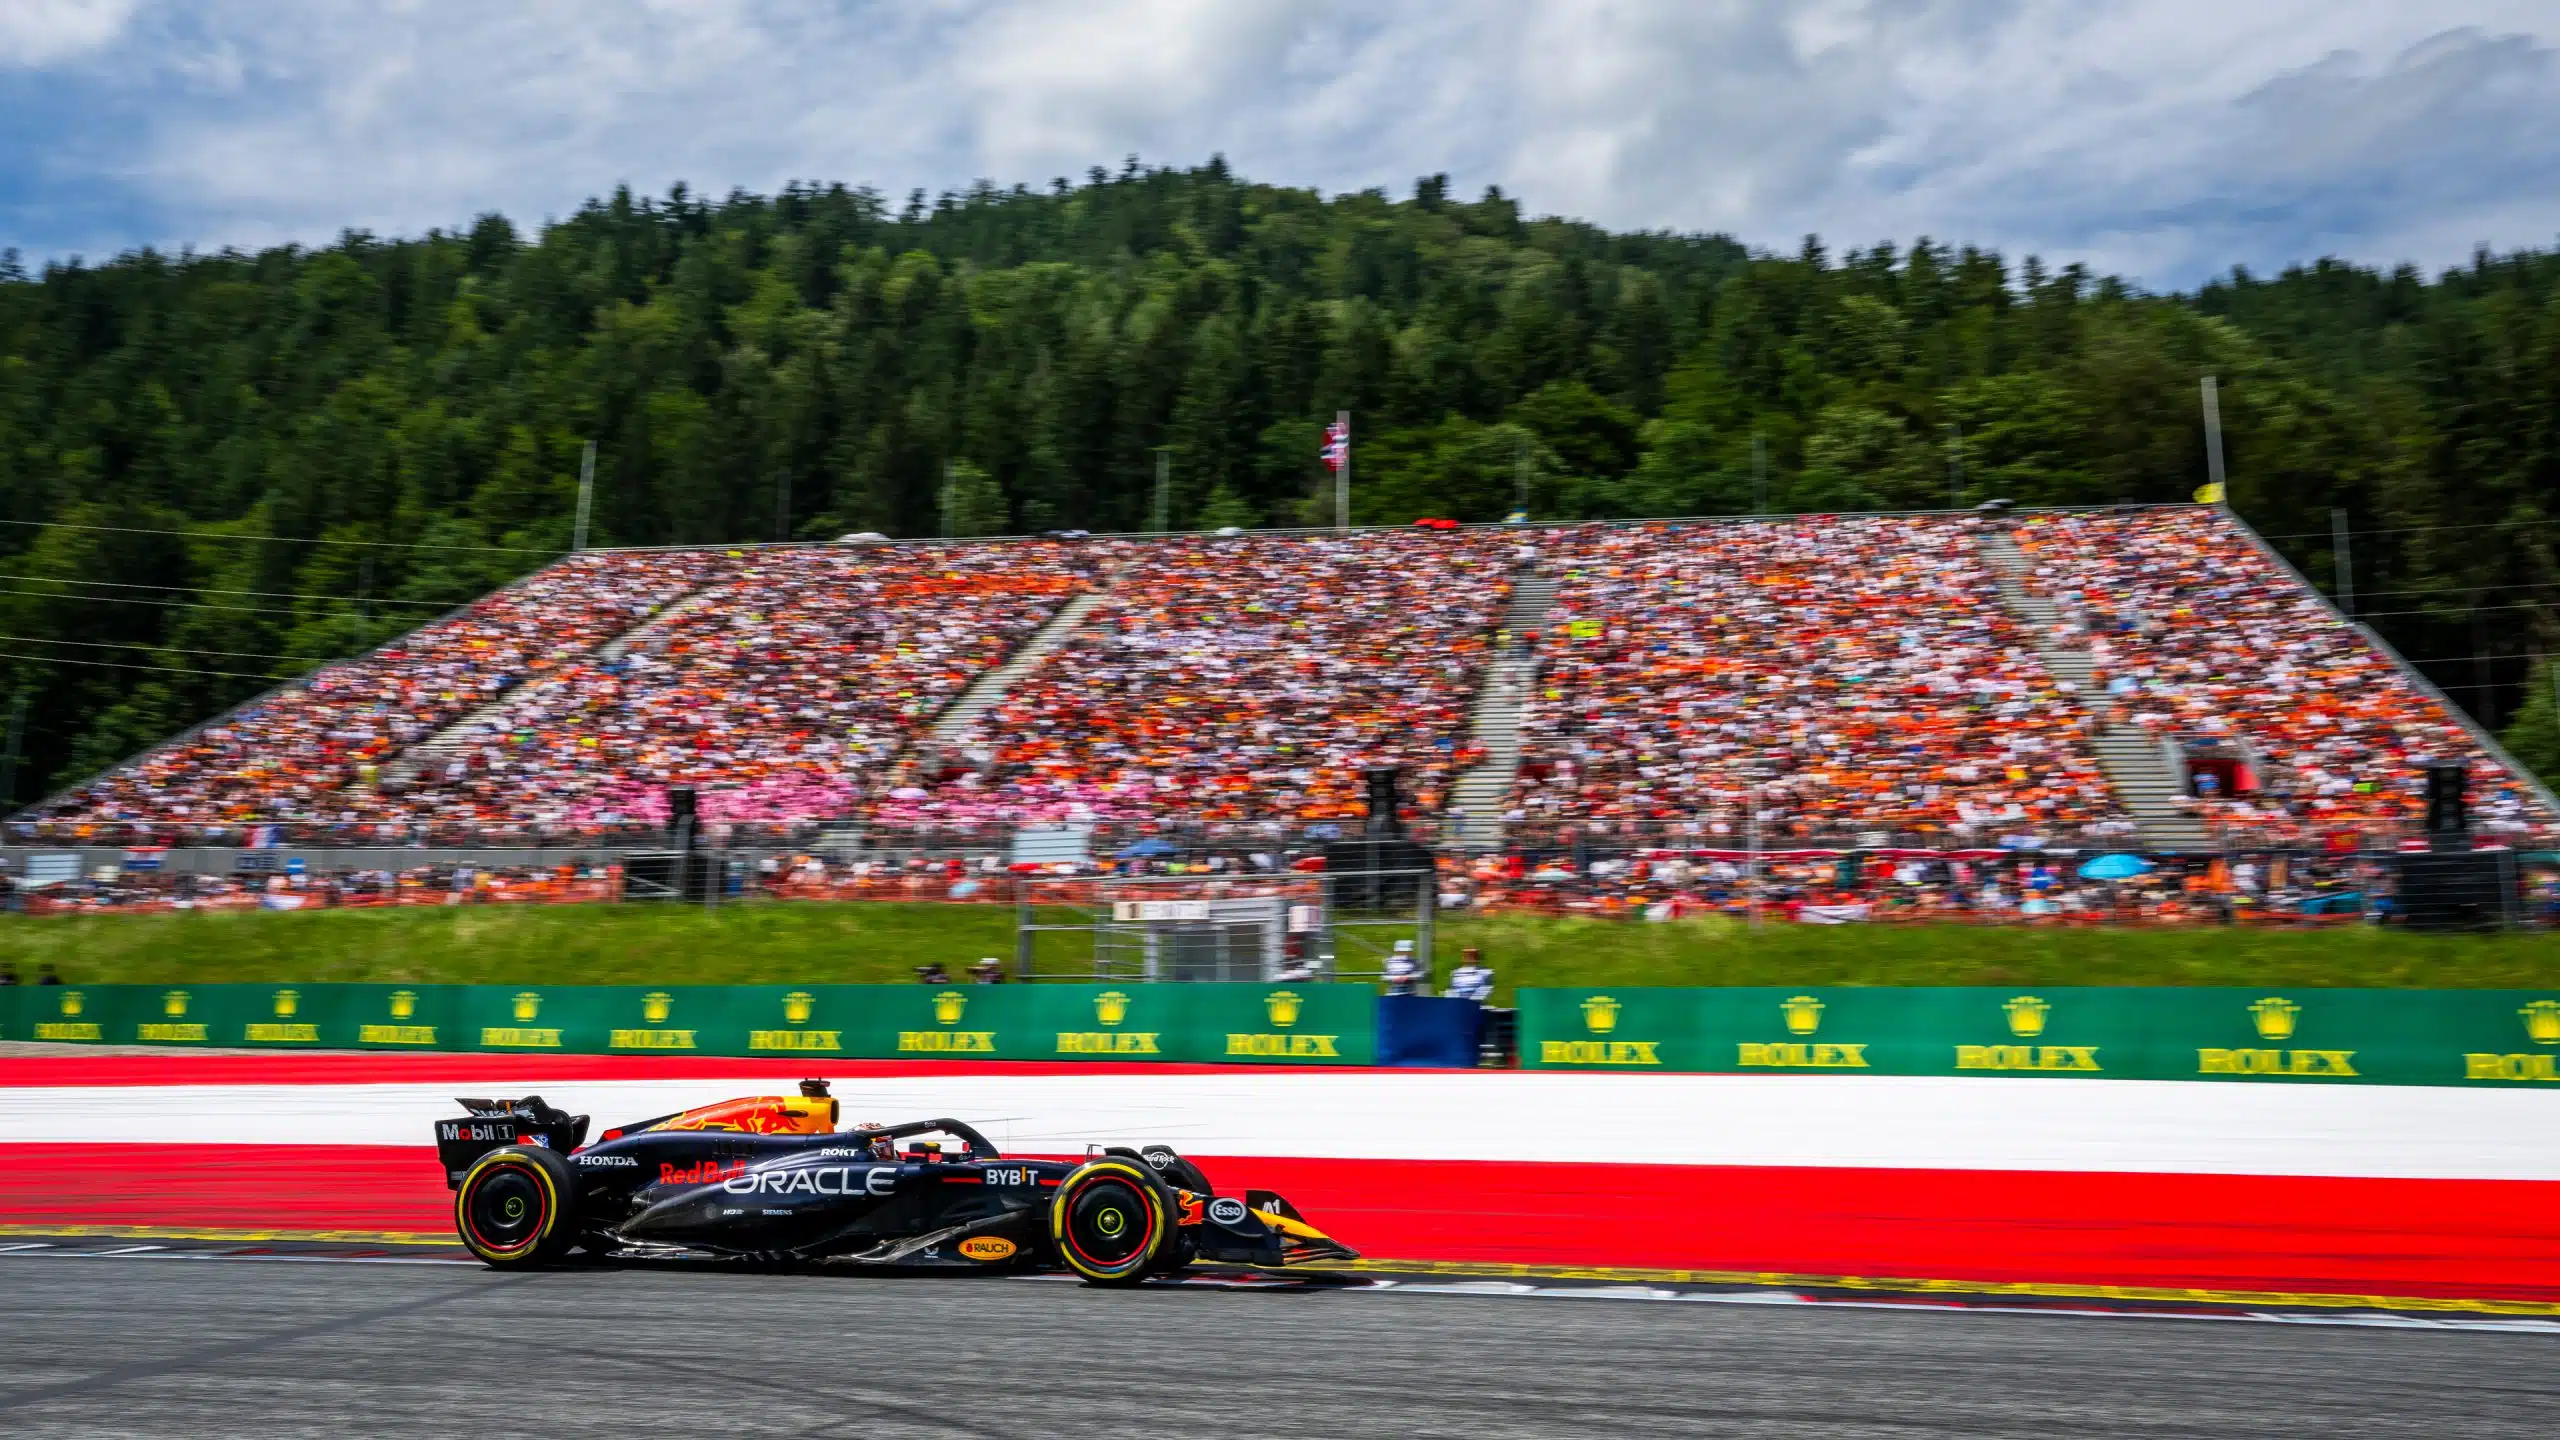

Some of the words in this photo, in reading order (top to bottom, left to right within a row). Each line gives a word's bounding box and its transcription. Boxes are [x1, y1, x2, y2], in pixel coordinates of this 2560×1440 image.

[897, 1032, 995, 1052] ROLEX
[1055, 1033, 1160, 1054] ROLEX
[1225, 1034, 1340, 1057] ROLEX
[1540, 1041, 1661, 1065] ROLEX
[1737, 1043, 1870, 1068] ROLEX
[1955, 1046, 2103, 1071] ROLEX
[2198, 1049, 2358, 1077] ROLEX
[442, 1124, 495, 1140] Mobil
[579, 1156, 638, 1166] HONDA
[820, 1148, 858, 1157] ROKT
[660, 1161, 700, 1185] Red
[704, 1160, 747, 1183] Bull
[723, 1167, 897, 1196] ORACLE
[986, 1166, 1038, 1186] BYBIT
[1215, 1204, 1241, 1217] Esso
[974, 1244, 1009, 1253] RAUCH
